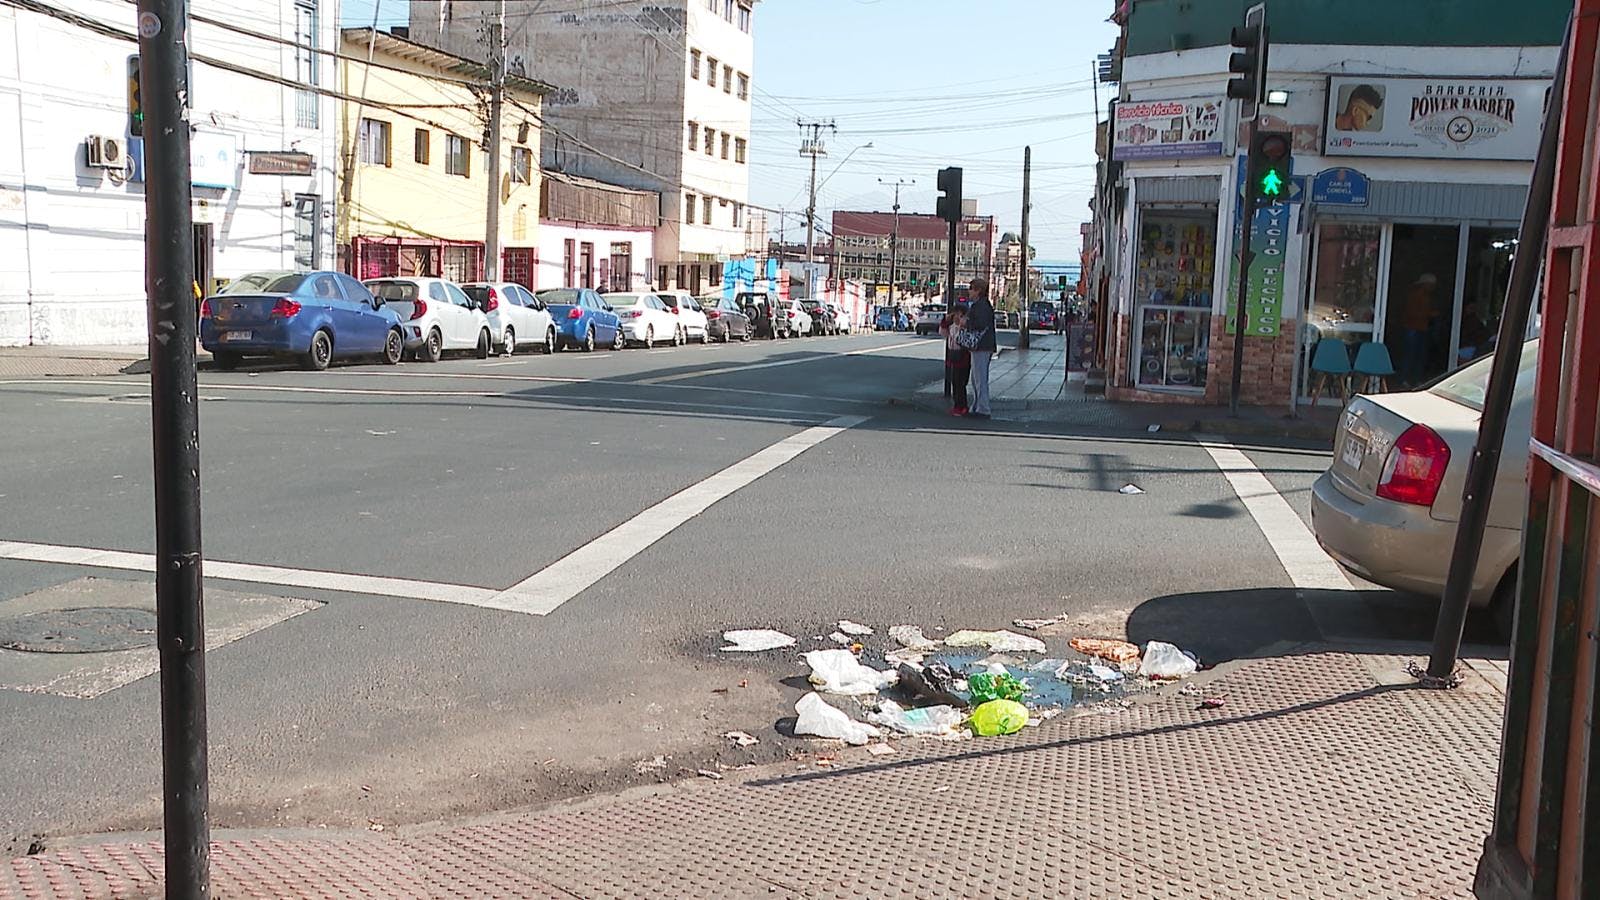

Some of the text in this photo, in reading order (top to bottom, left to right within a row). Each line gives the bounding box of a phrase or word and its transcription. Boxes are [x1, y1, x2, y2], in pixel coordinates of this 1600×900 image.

[1425, 85, 1504, 96] BARBERIA
[1118, 102, 1184, 119] Servicio técnico
[1410, 97, 1515, 124] POWER BARBER
[1257, 267, 1279, 335] TECNICO
